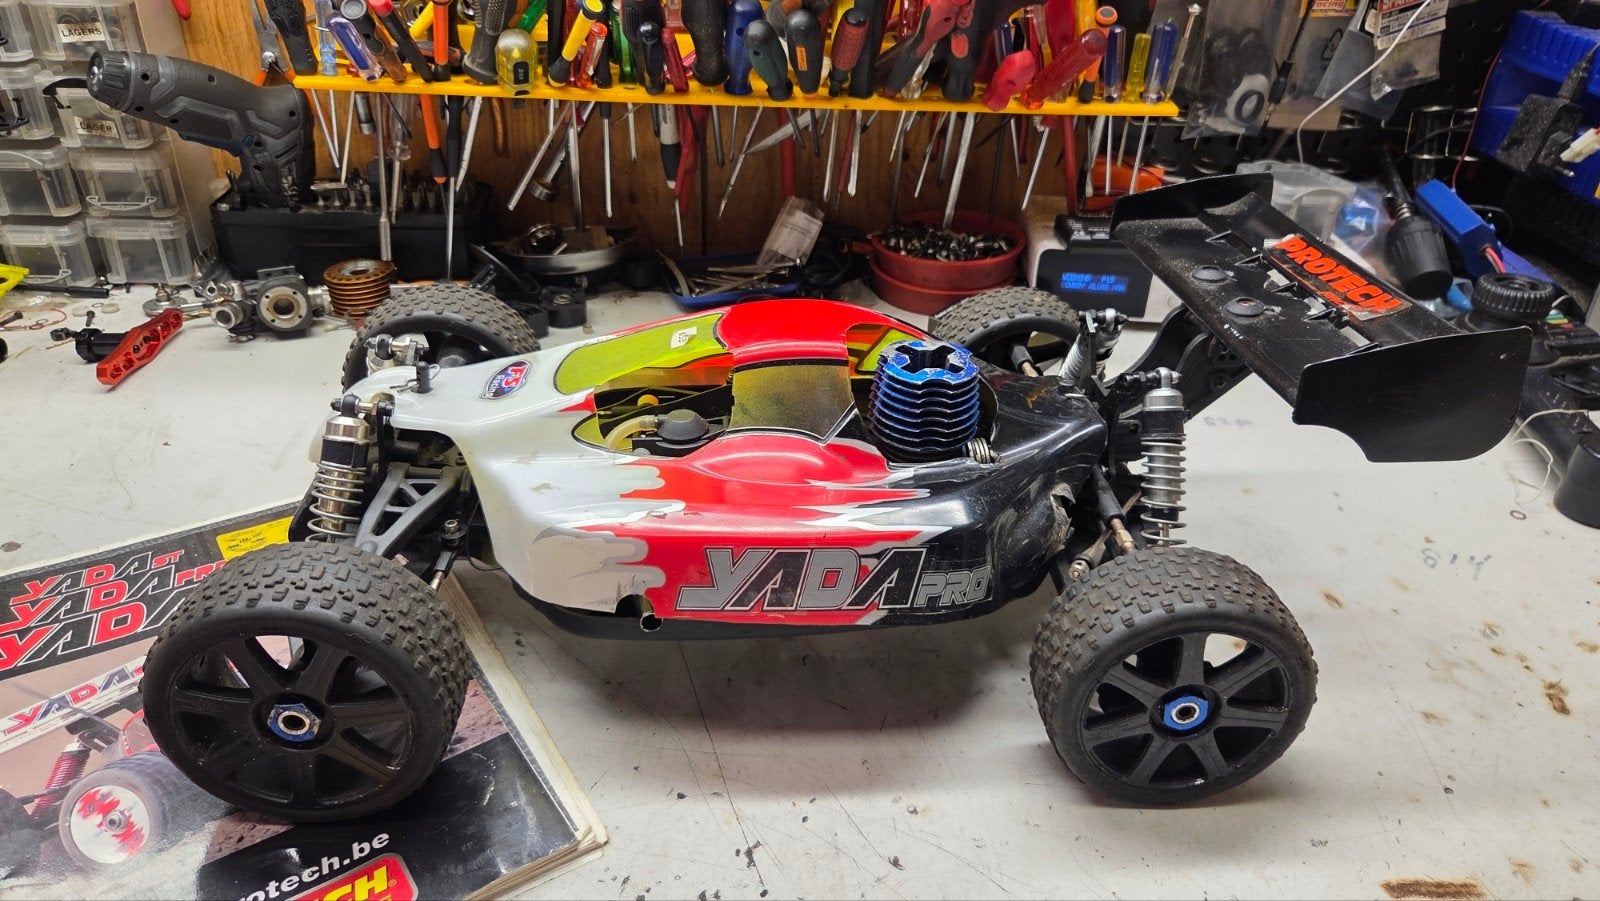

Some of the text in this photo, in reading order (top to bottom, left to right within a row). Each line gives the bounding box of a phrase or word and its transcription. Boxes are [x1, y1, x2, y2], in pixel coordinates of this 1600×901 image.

[61, 27, 102, 37] LAGERS
[80, 121, 112, 132] LAGER
[1275, 236, 1402, 309] PROTECH
[0, 564, 175, 634] YADA
[9, 549, 184, 605] YADA ST
[675, 547, 992, 611] YADA PRO
[4, 665, 134, 736] YADA
[239, 833, 390, 901] otech.be
